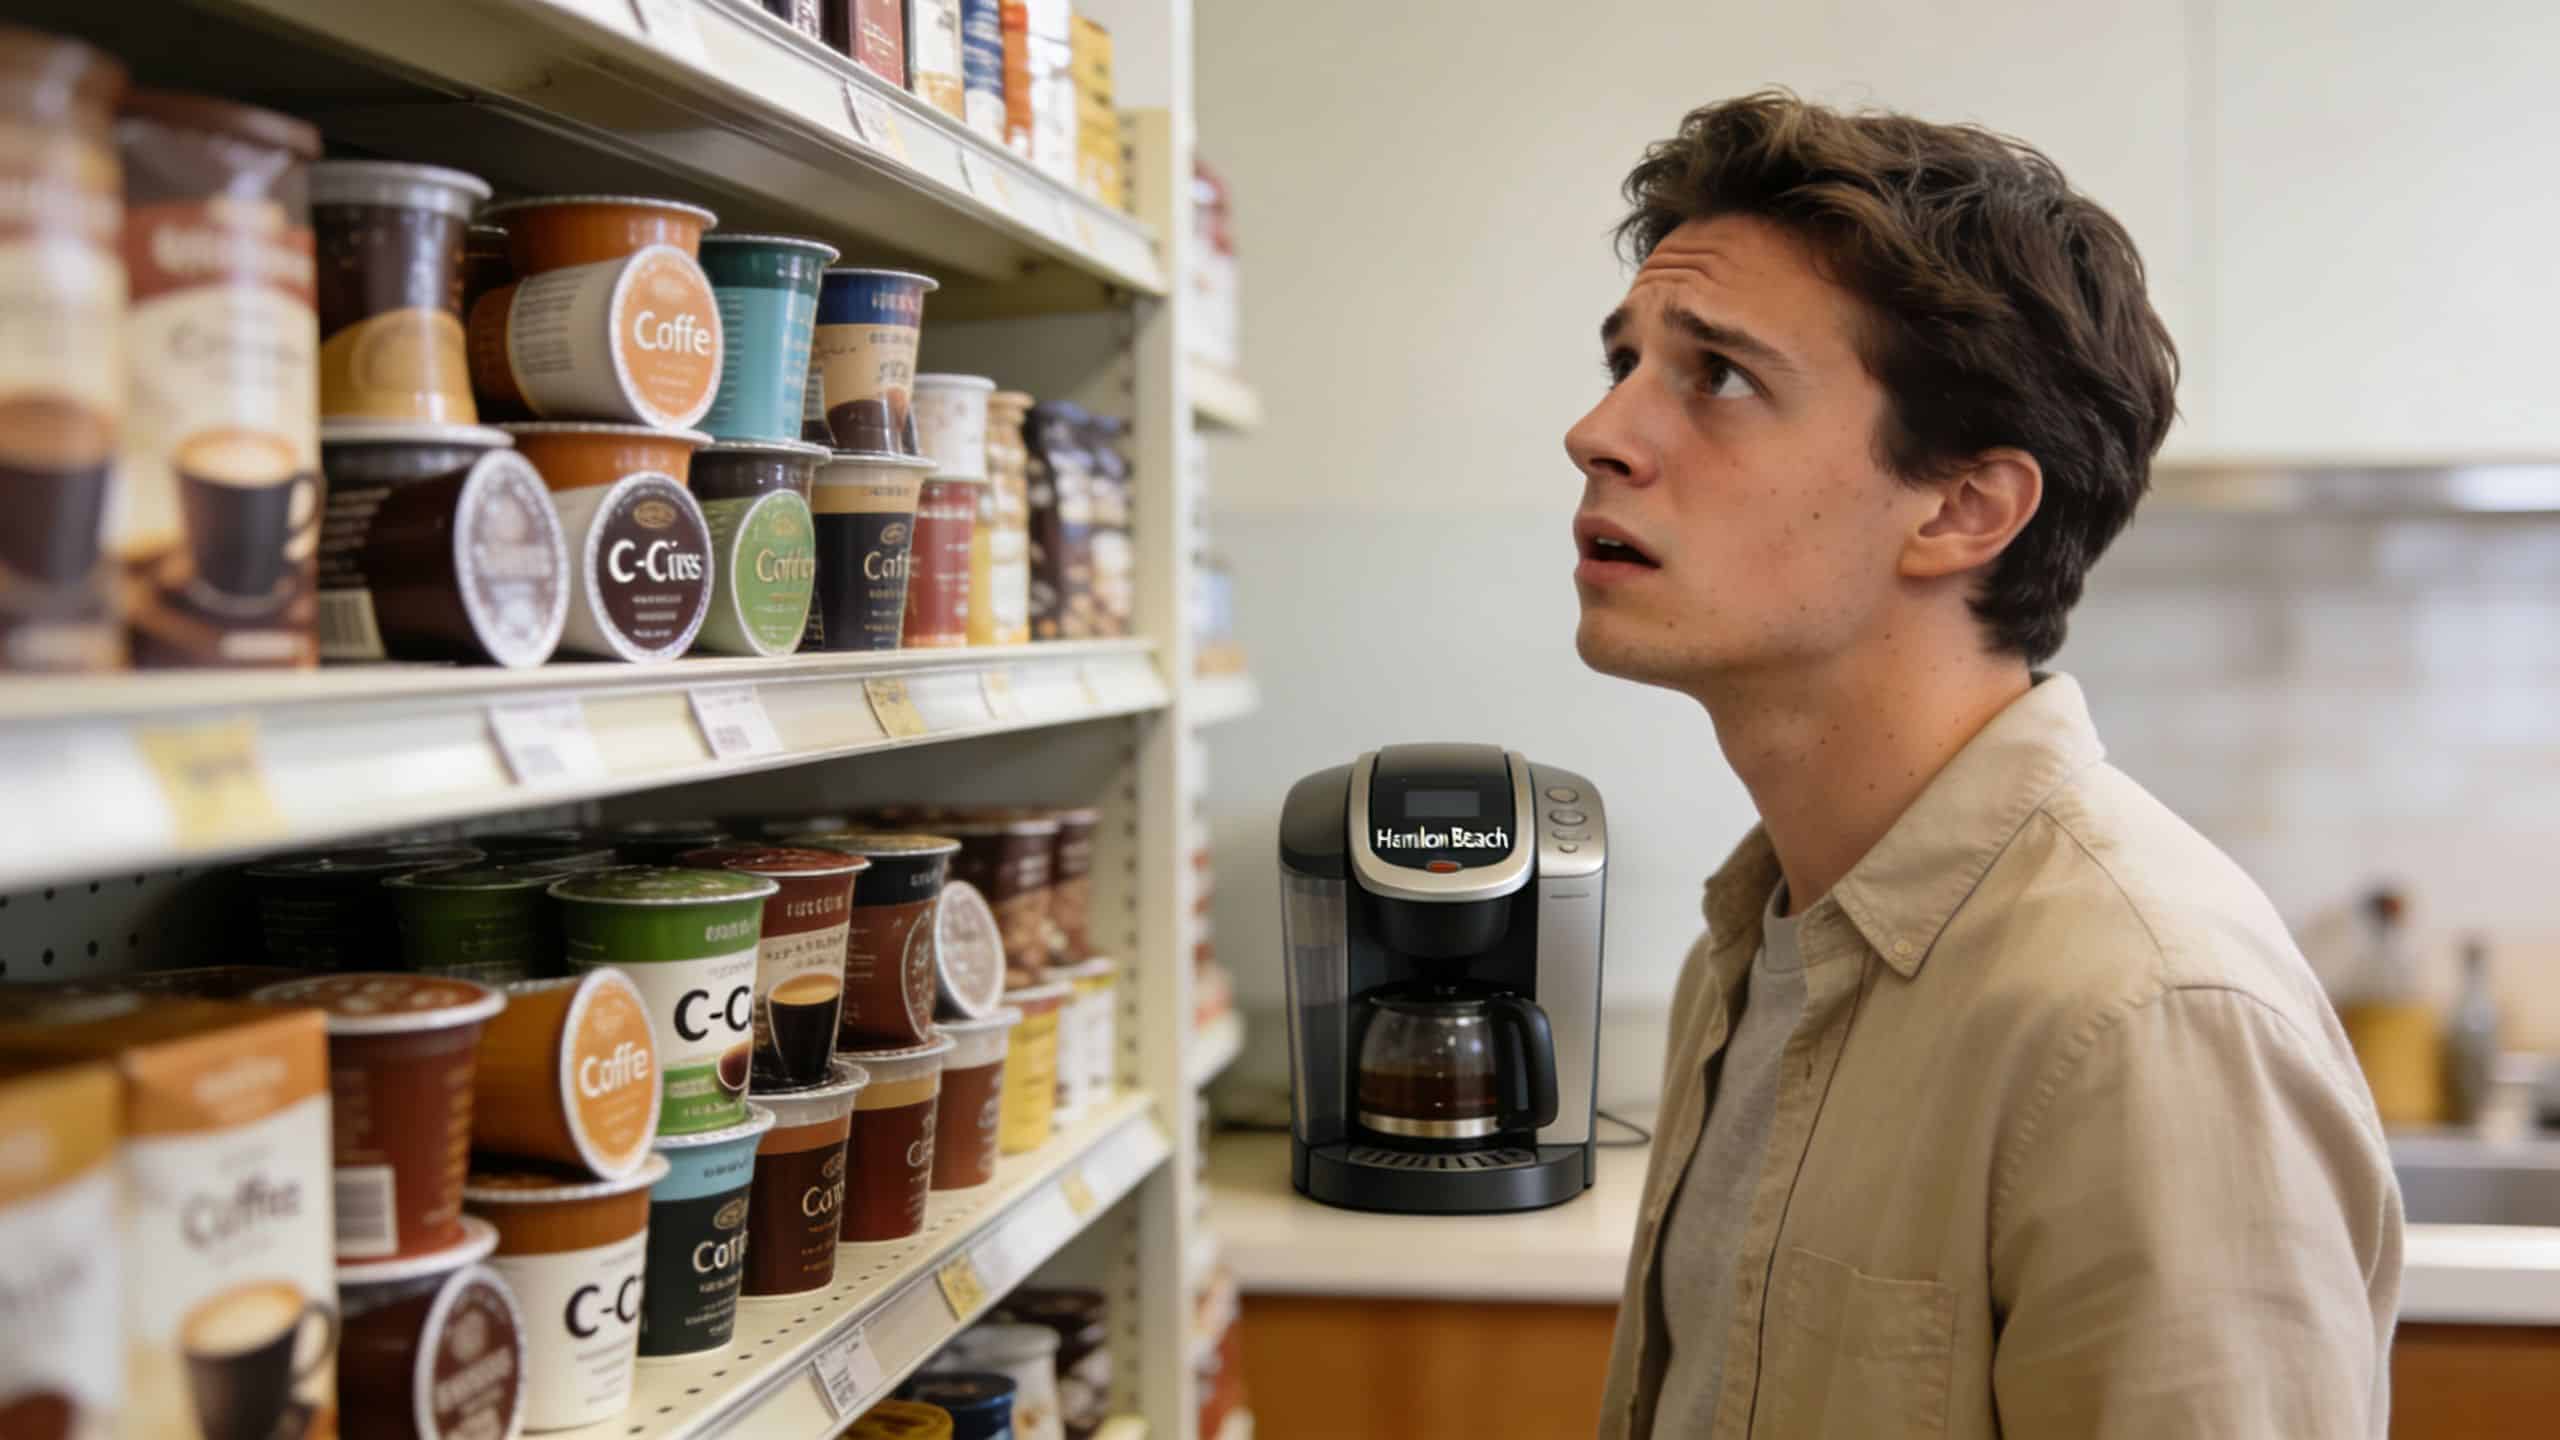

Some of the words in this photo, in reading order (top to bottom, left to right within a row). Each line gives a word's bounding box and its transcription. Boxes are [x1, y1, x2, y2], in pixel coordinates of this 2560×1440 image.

[633, 311, 711, 356] Coffe
[1451, 826, 1509, 848] Beach
[579, 1041, 649, 1098] Coffe
